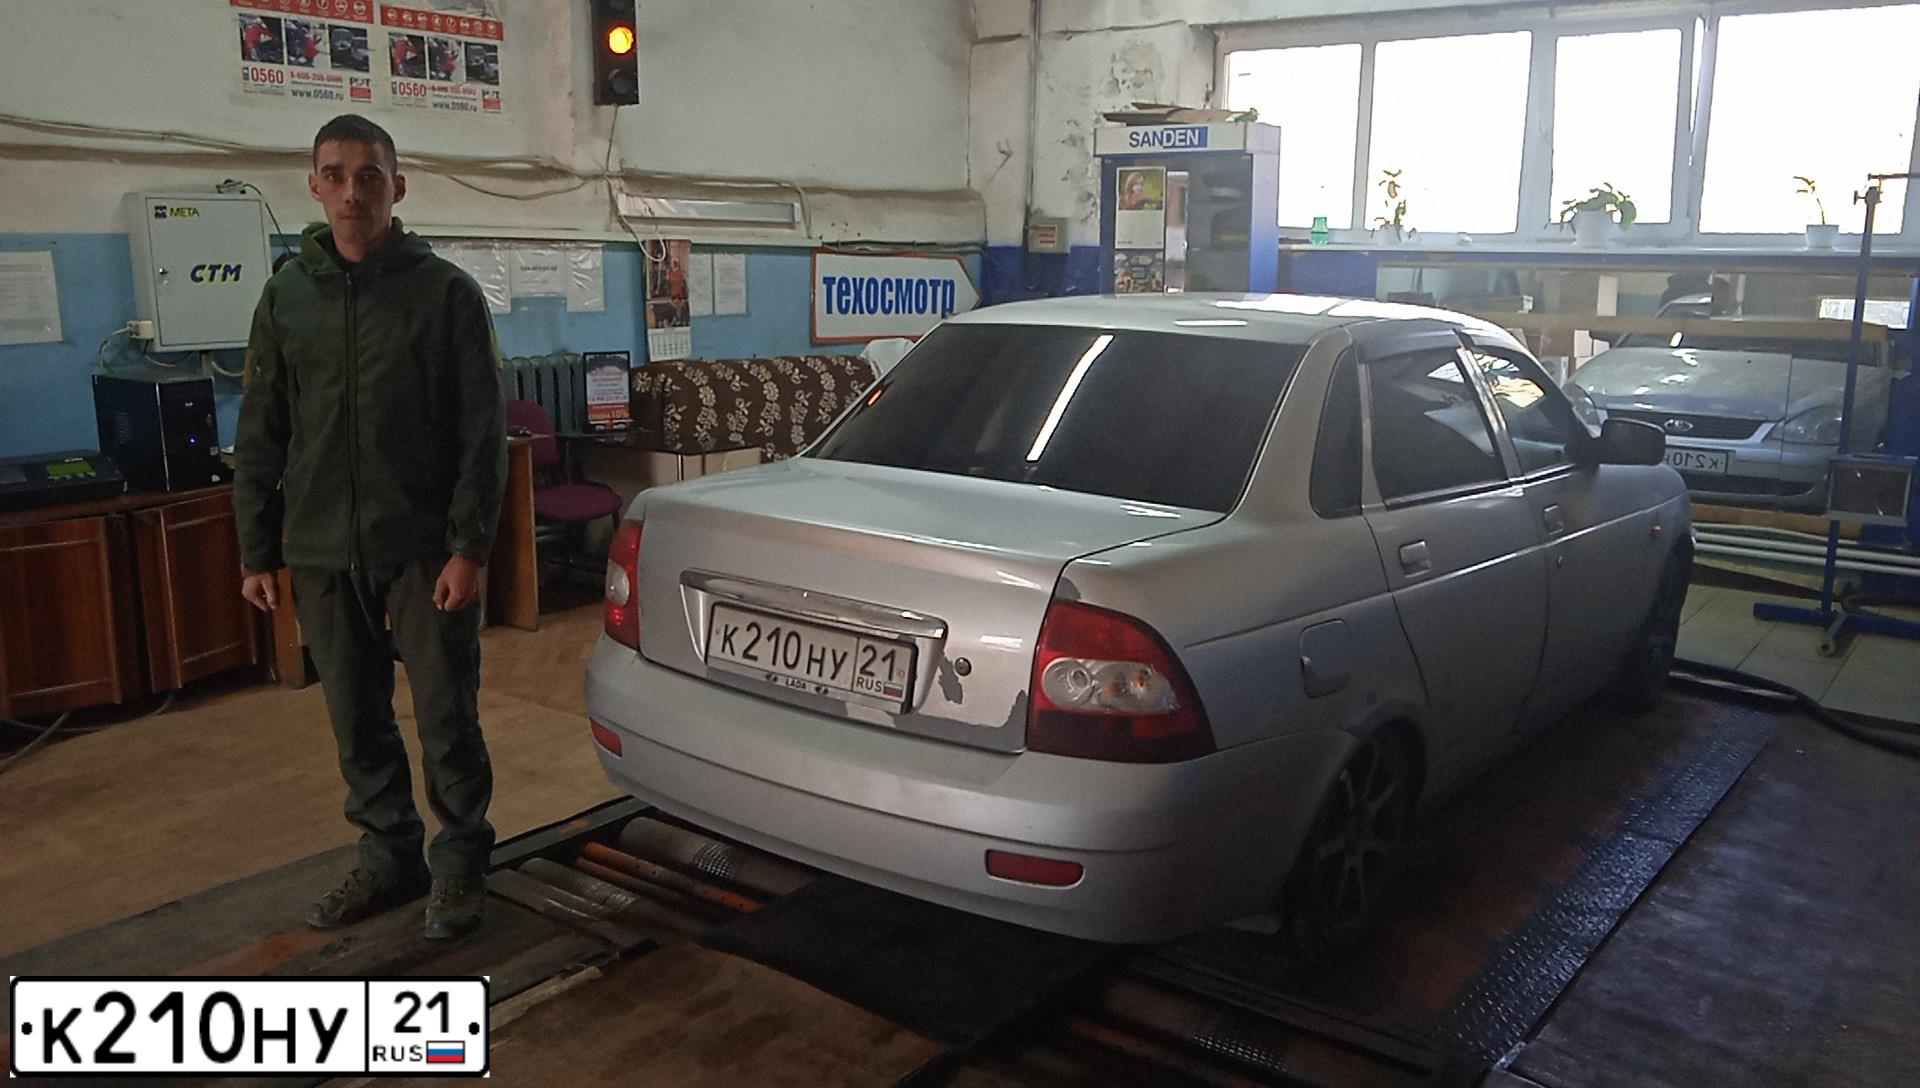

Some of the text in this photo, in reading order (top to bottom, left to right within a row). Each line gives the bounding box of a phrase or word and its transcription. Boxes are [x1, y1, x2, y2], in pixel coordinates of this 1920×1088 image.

[250, 66, 284, 84] 0560
[398, 81, 427, 97] 0560
[1129, 129, 1200, 148] SANDEN
[169, 207, 200, 218] META
[858, 644, 897, 681] 21
[856, 677, 882, 693] RUS
